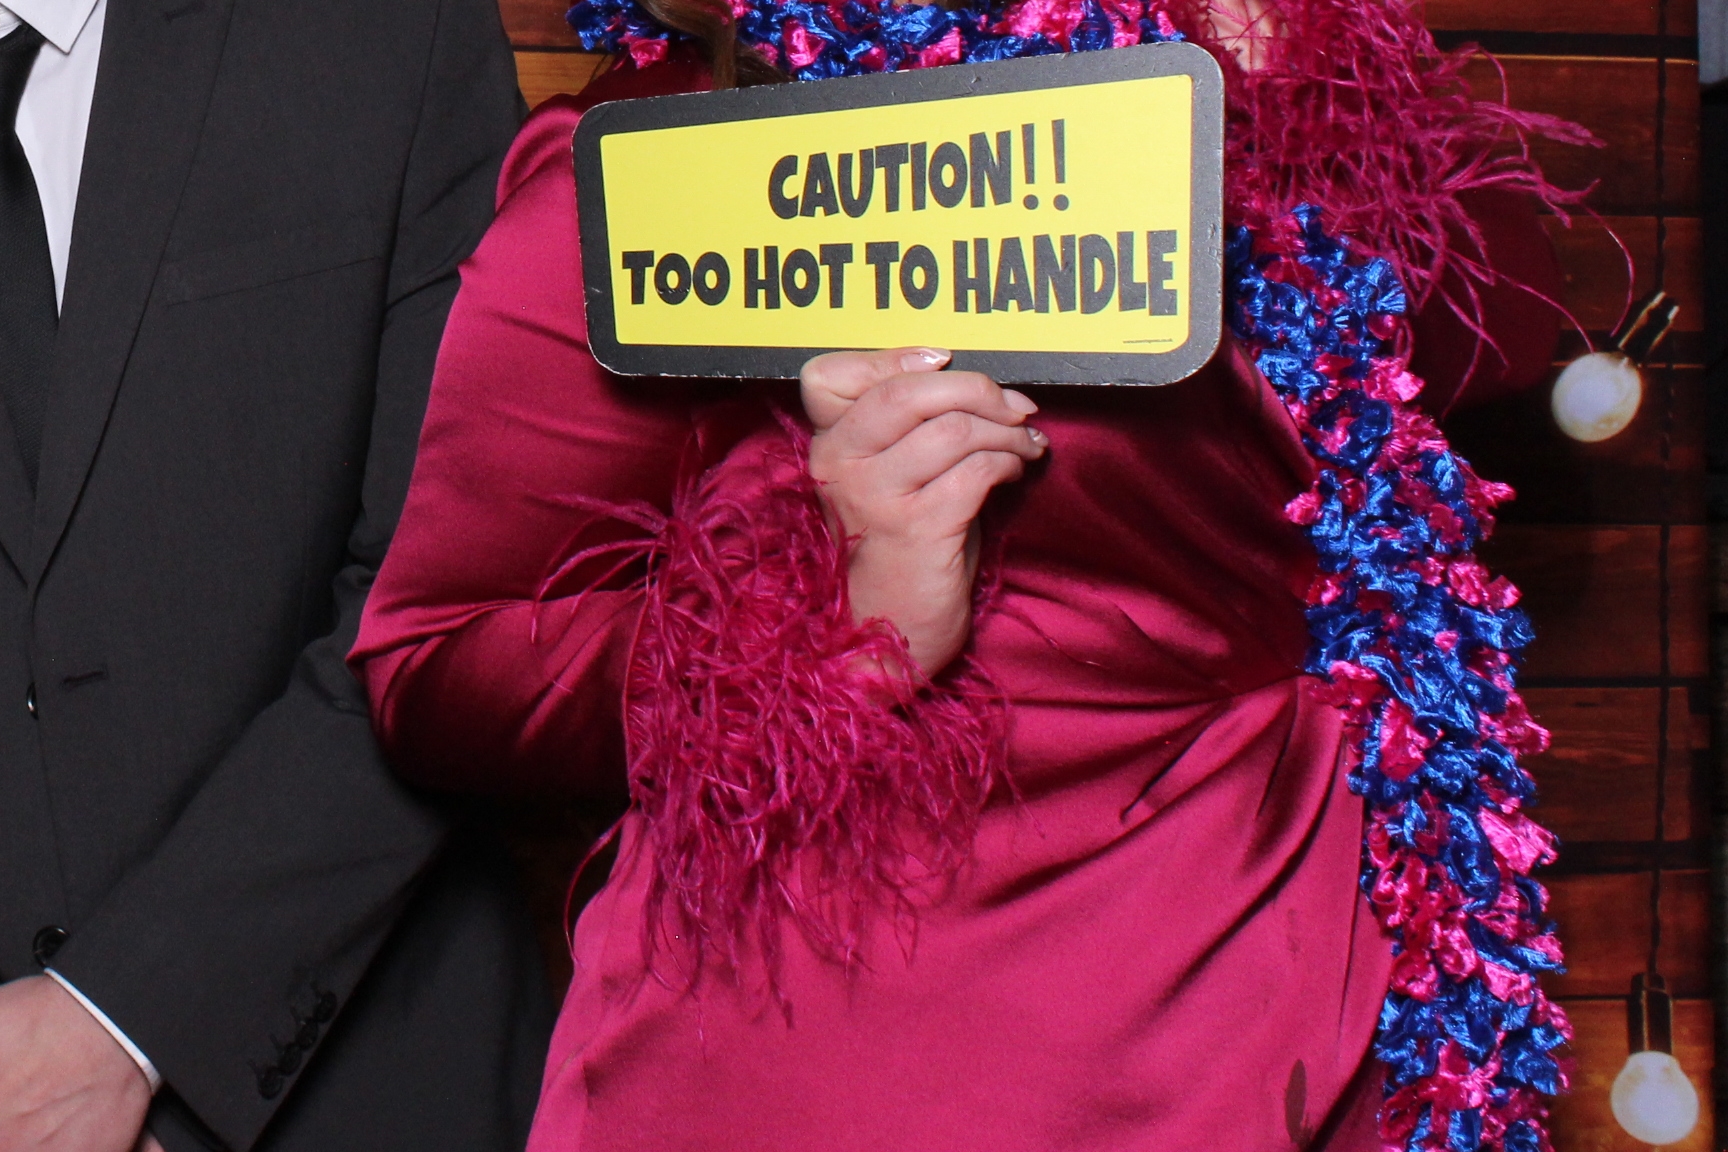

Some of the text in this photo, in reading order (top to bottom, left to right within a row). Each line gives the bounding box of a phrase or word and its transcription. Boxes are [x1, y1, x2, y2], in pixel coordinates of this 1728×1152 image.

[768, 118, 1070, 220] CAUTION!!
[622, 228, 1178, 317] TOO HOT TO HANDLE
